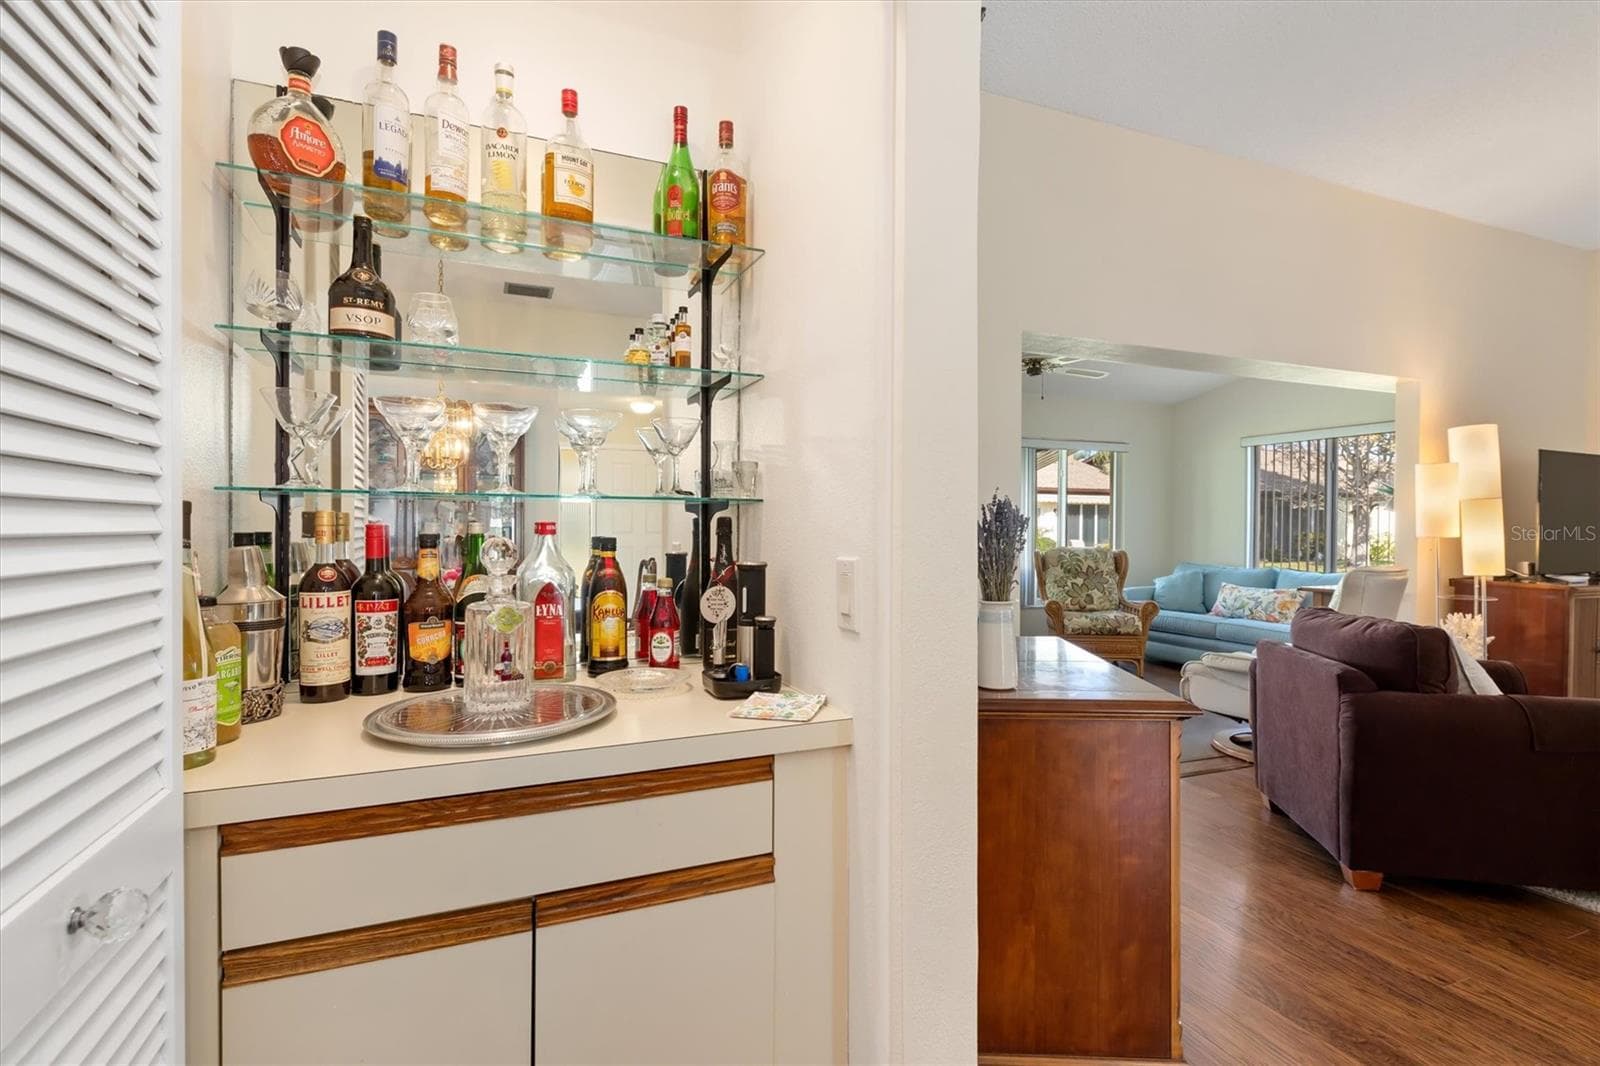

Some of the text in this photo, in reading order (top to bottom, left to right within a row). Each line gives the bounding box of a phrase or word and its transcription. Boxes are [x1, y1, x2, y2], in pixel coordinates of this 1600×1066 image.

[289, 127, 326, 149] Amore
[346, 313, 381, 326] VSOP
[301, 595, 350, 609] LILLET
